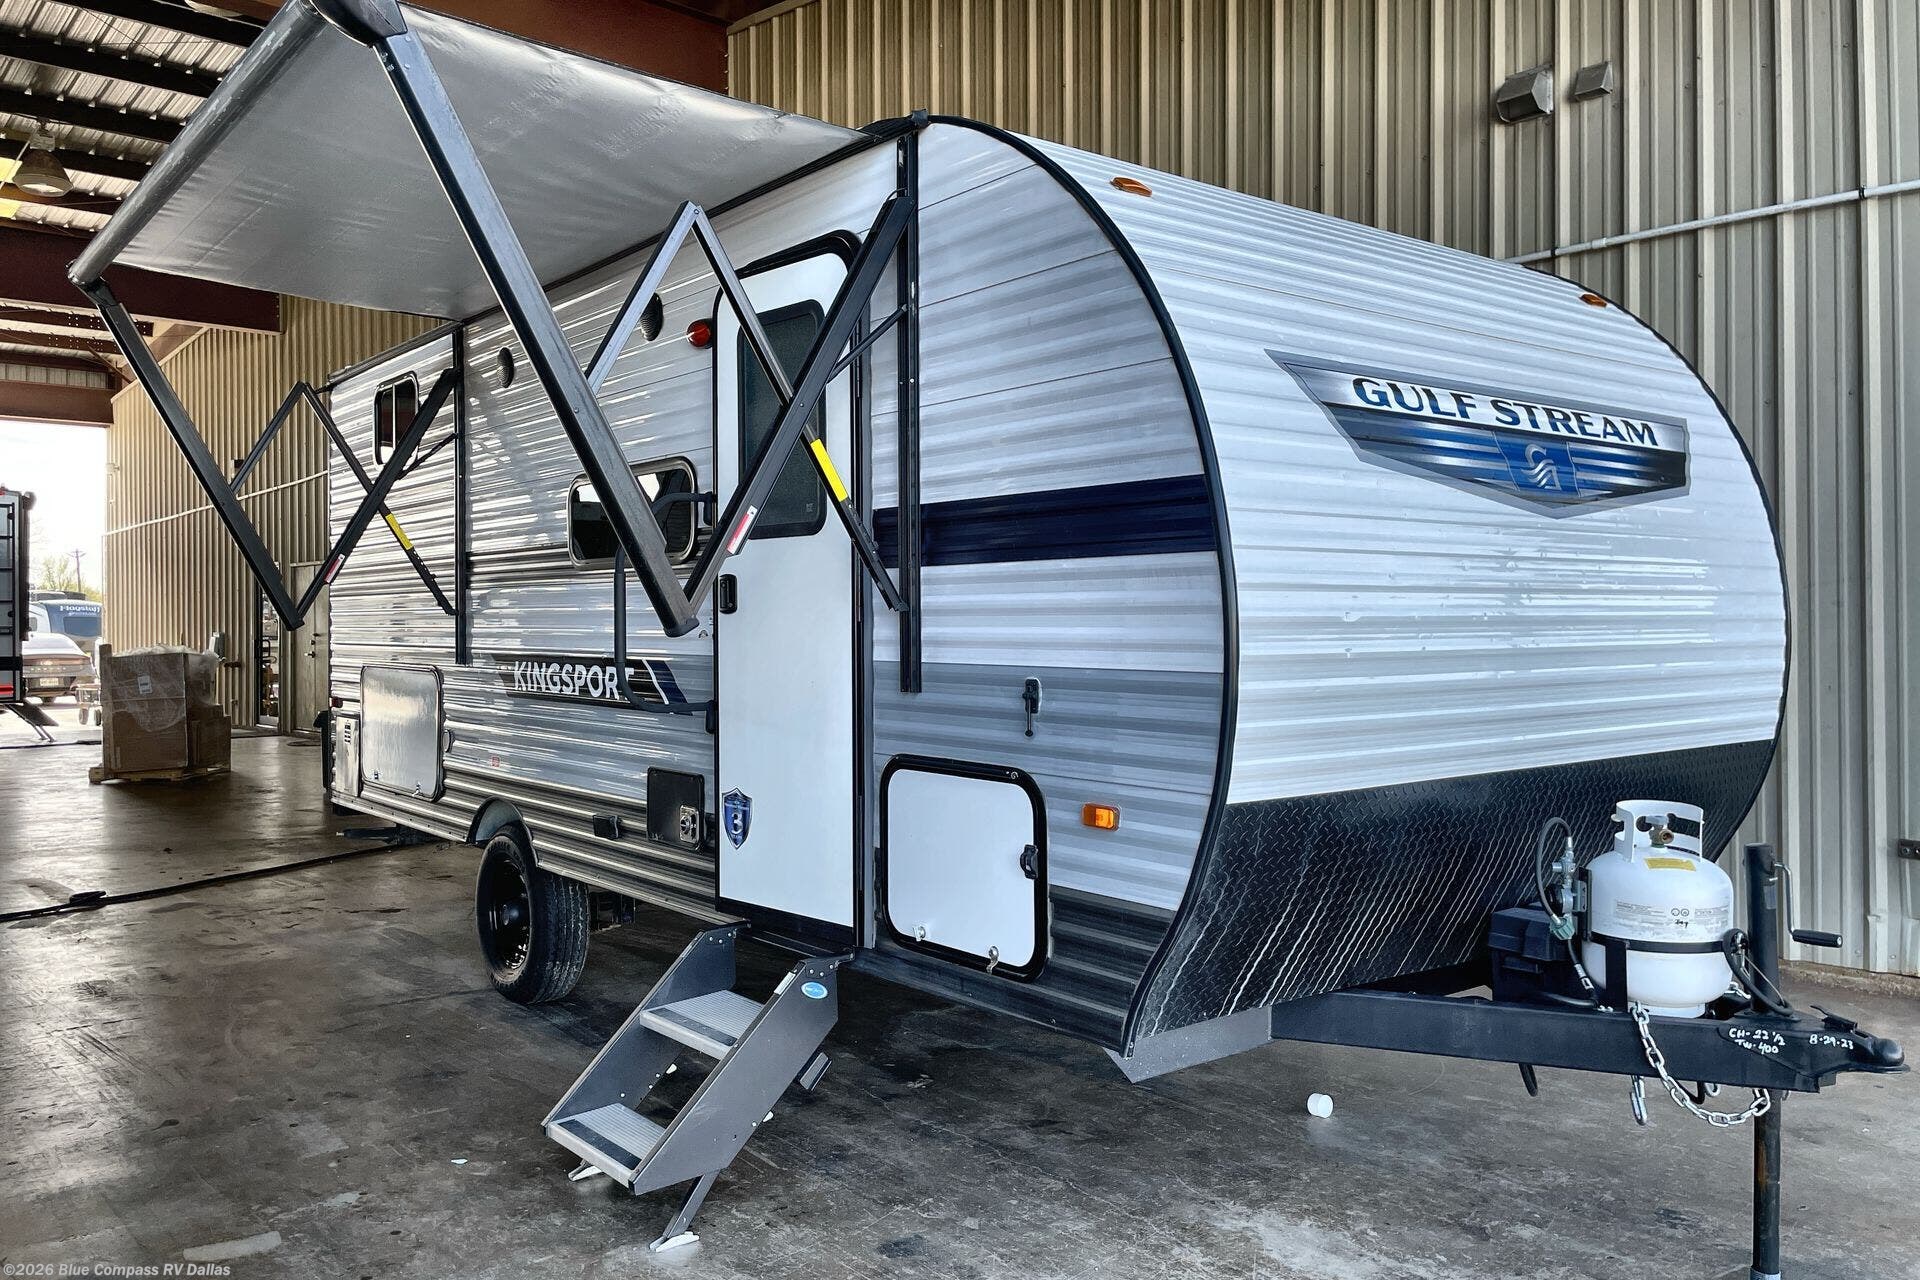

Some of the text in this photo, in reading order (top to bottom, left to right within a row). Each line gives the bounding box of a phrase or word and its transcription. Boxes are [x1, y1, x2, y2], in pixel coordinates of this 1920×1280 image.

[1352, 377, 1659, 447] GULF STREAM
[731, 812, 744, 834] 3
